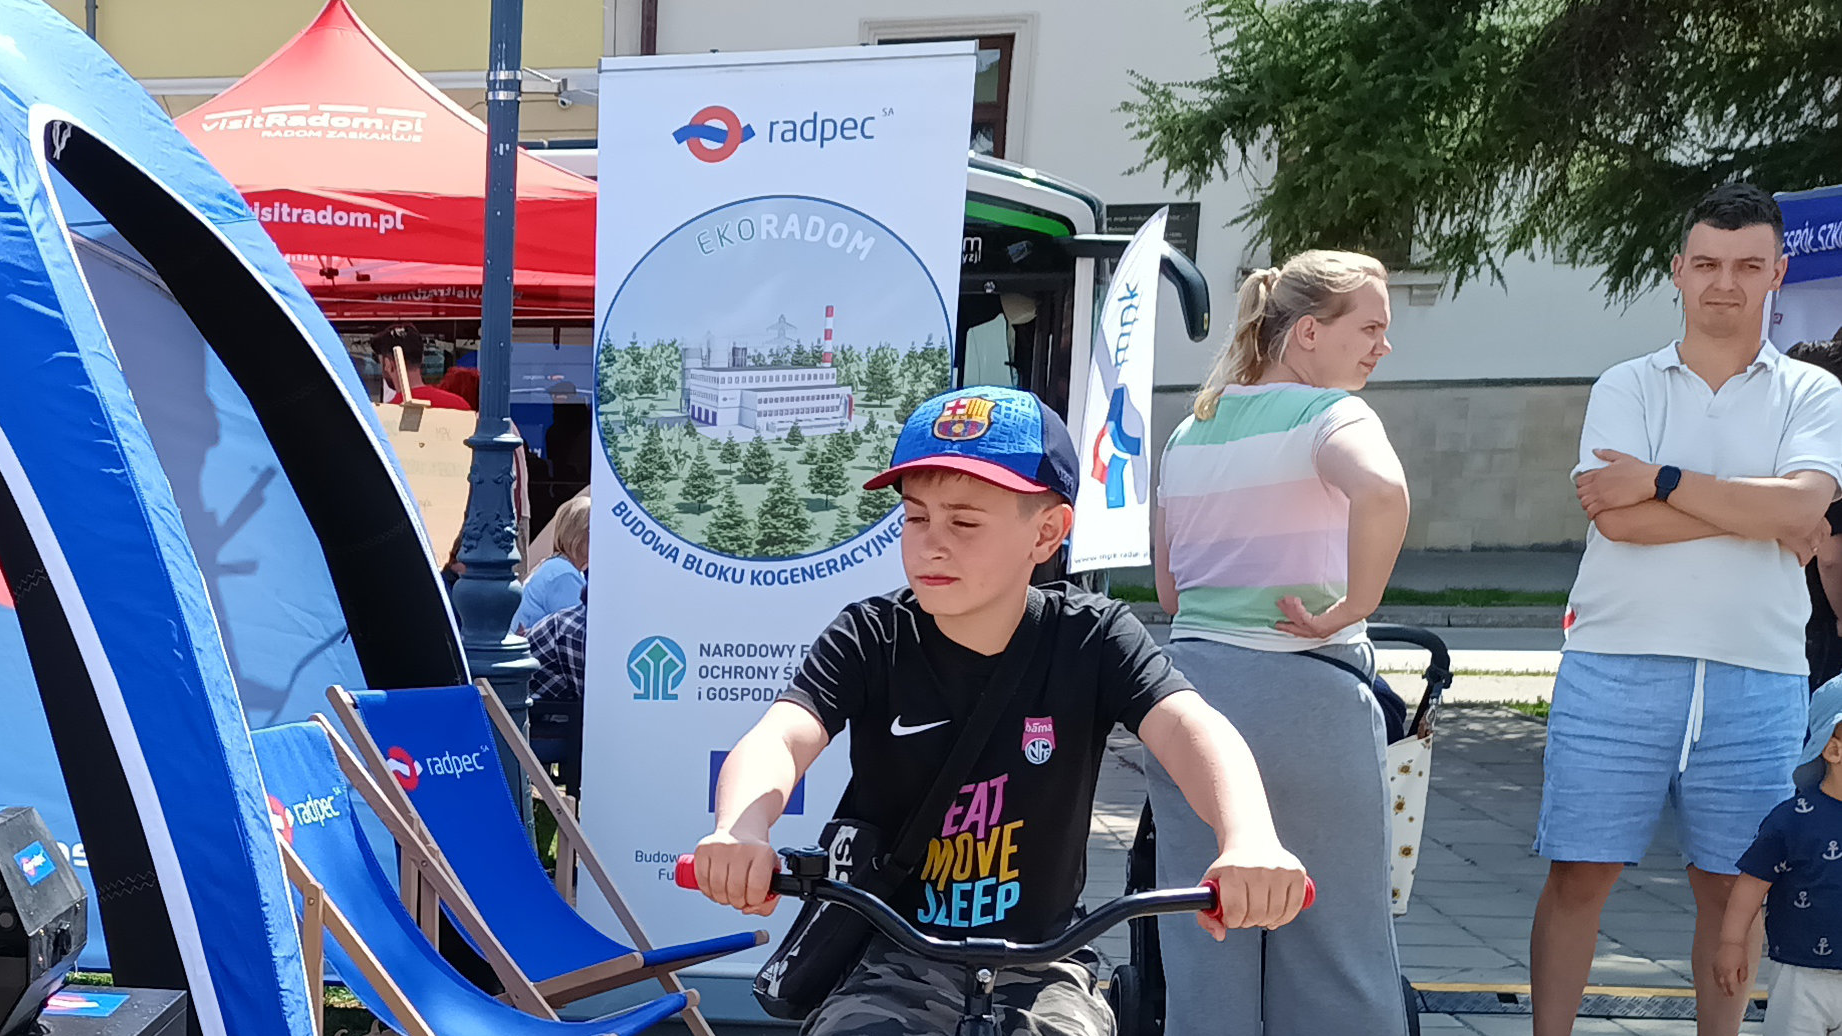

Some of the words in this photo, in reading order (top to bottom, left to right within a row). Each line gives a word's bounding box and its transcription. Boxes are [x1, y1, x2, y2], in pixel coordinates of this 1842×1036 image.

[201, 112, 424, 134] visitRadom.pl
[261, 129, 322, 139] RADOM
[325, 131, 423, 143] ZASKAKUJE
[768, 111, 876, 149] radpec
[881, 107, 895, 117] SA
[248, 202, 405, 234] isitradom.pl
[695, 212, 876, 262] EKORADOM
[611, 501, 680, 564] BUDOWA
[681, 553, 746, 586] BLOKU
[699, 643, 796, 659] NARODOWY
[800, 645, 811, 659] F
[698, 665, 780, 681] OCHRONY
[698, 686, 703, 702] i
[426, 751, 485, 780] radpec
[292, 794, 340, 828] radpec
[942, 773, 1009, 839] EAT
[920, 820, 1024, 891] MOVE
[917, 877, 1020, 928] SLEEP
